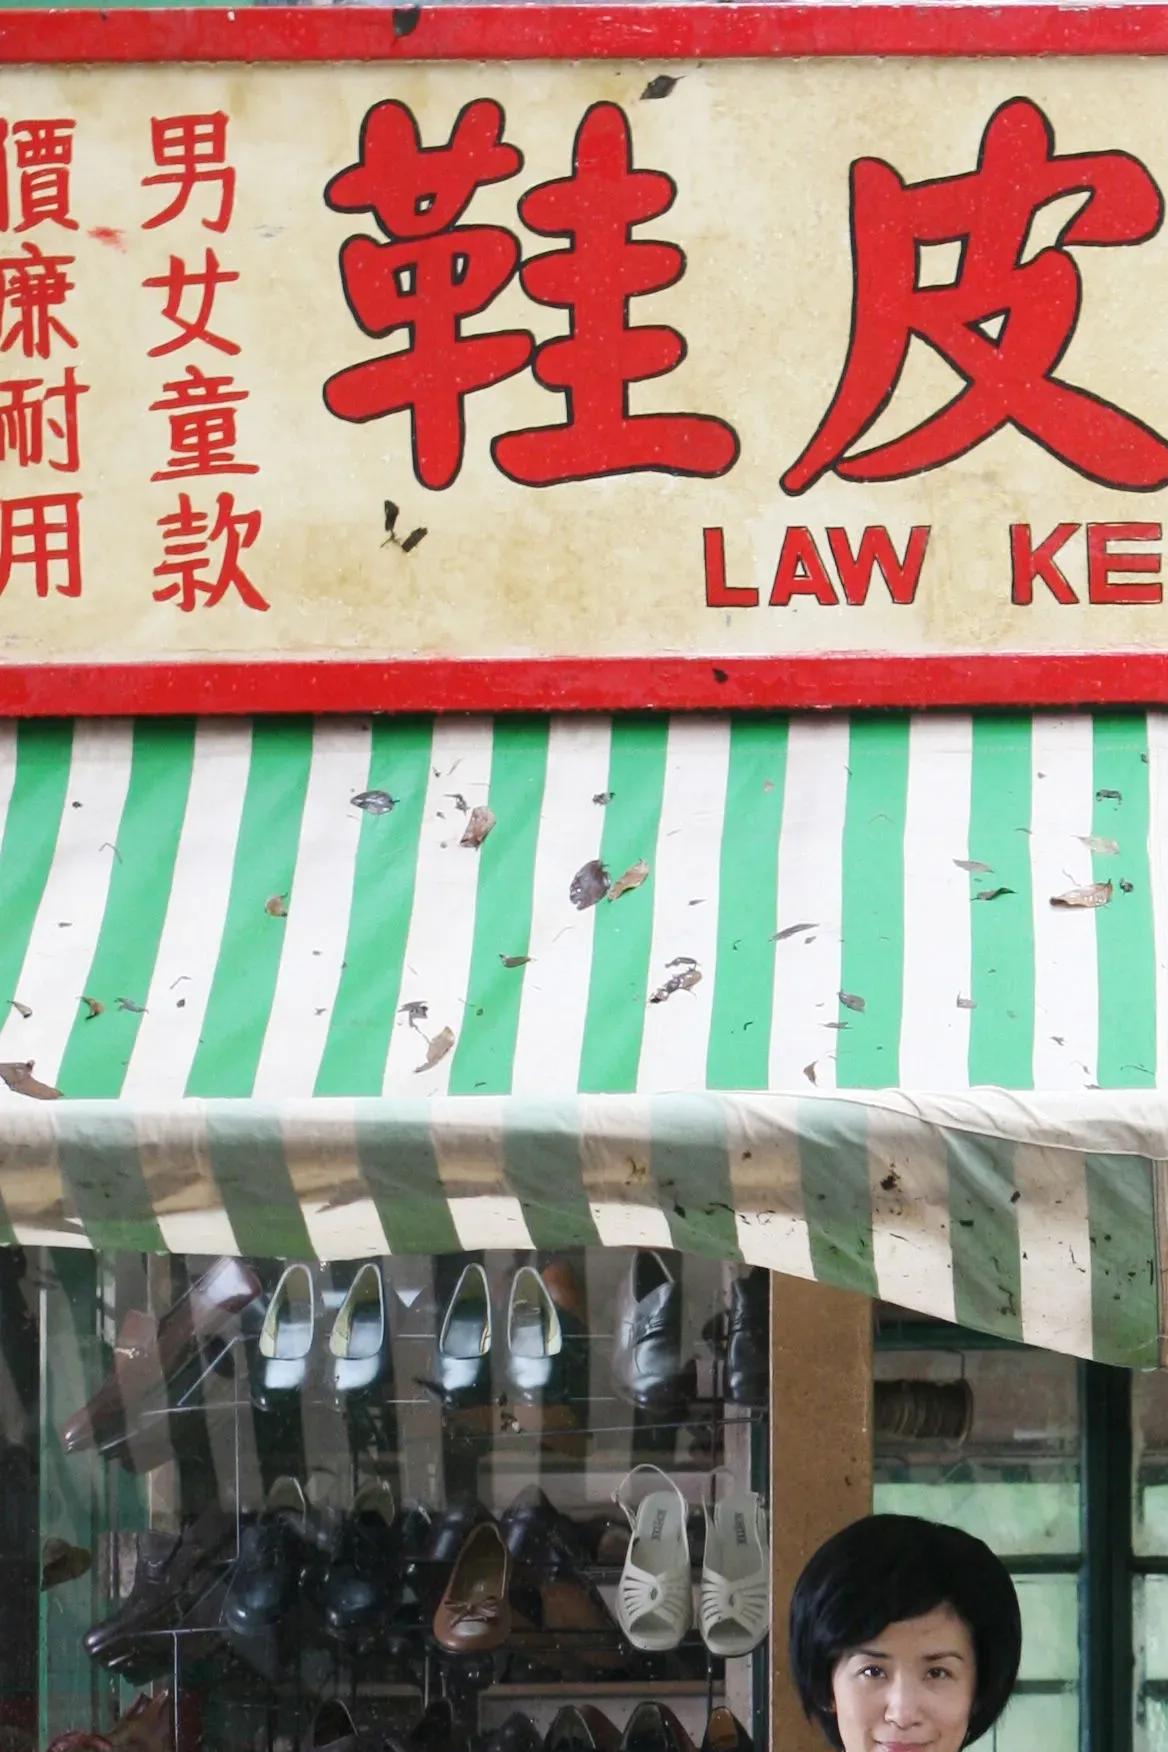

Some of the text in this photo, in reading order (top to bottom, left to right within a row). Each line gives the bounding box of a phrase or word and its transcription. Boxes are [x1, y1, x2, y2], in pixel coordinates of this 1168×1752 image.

[141, 110, 271, 613] 男女童款
[702, 525, 932, 608] LAW
